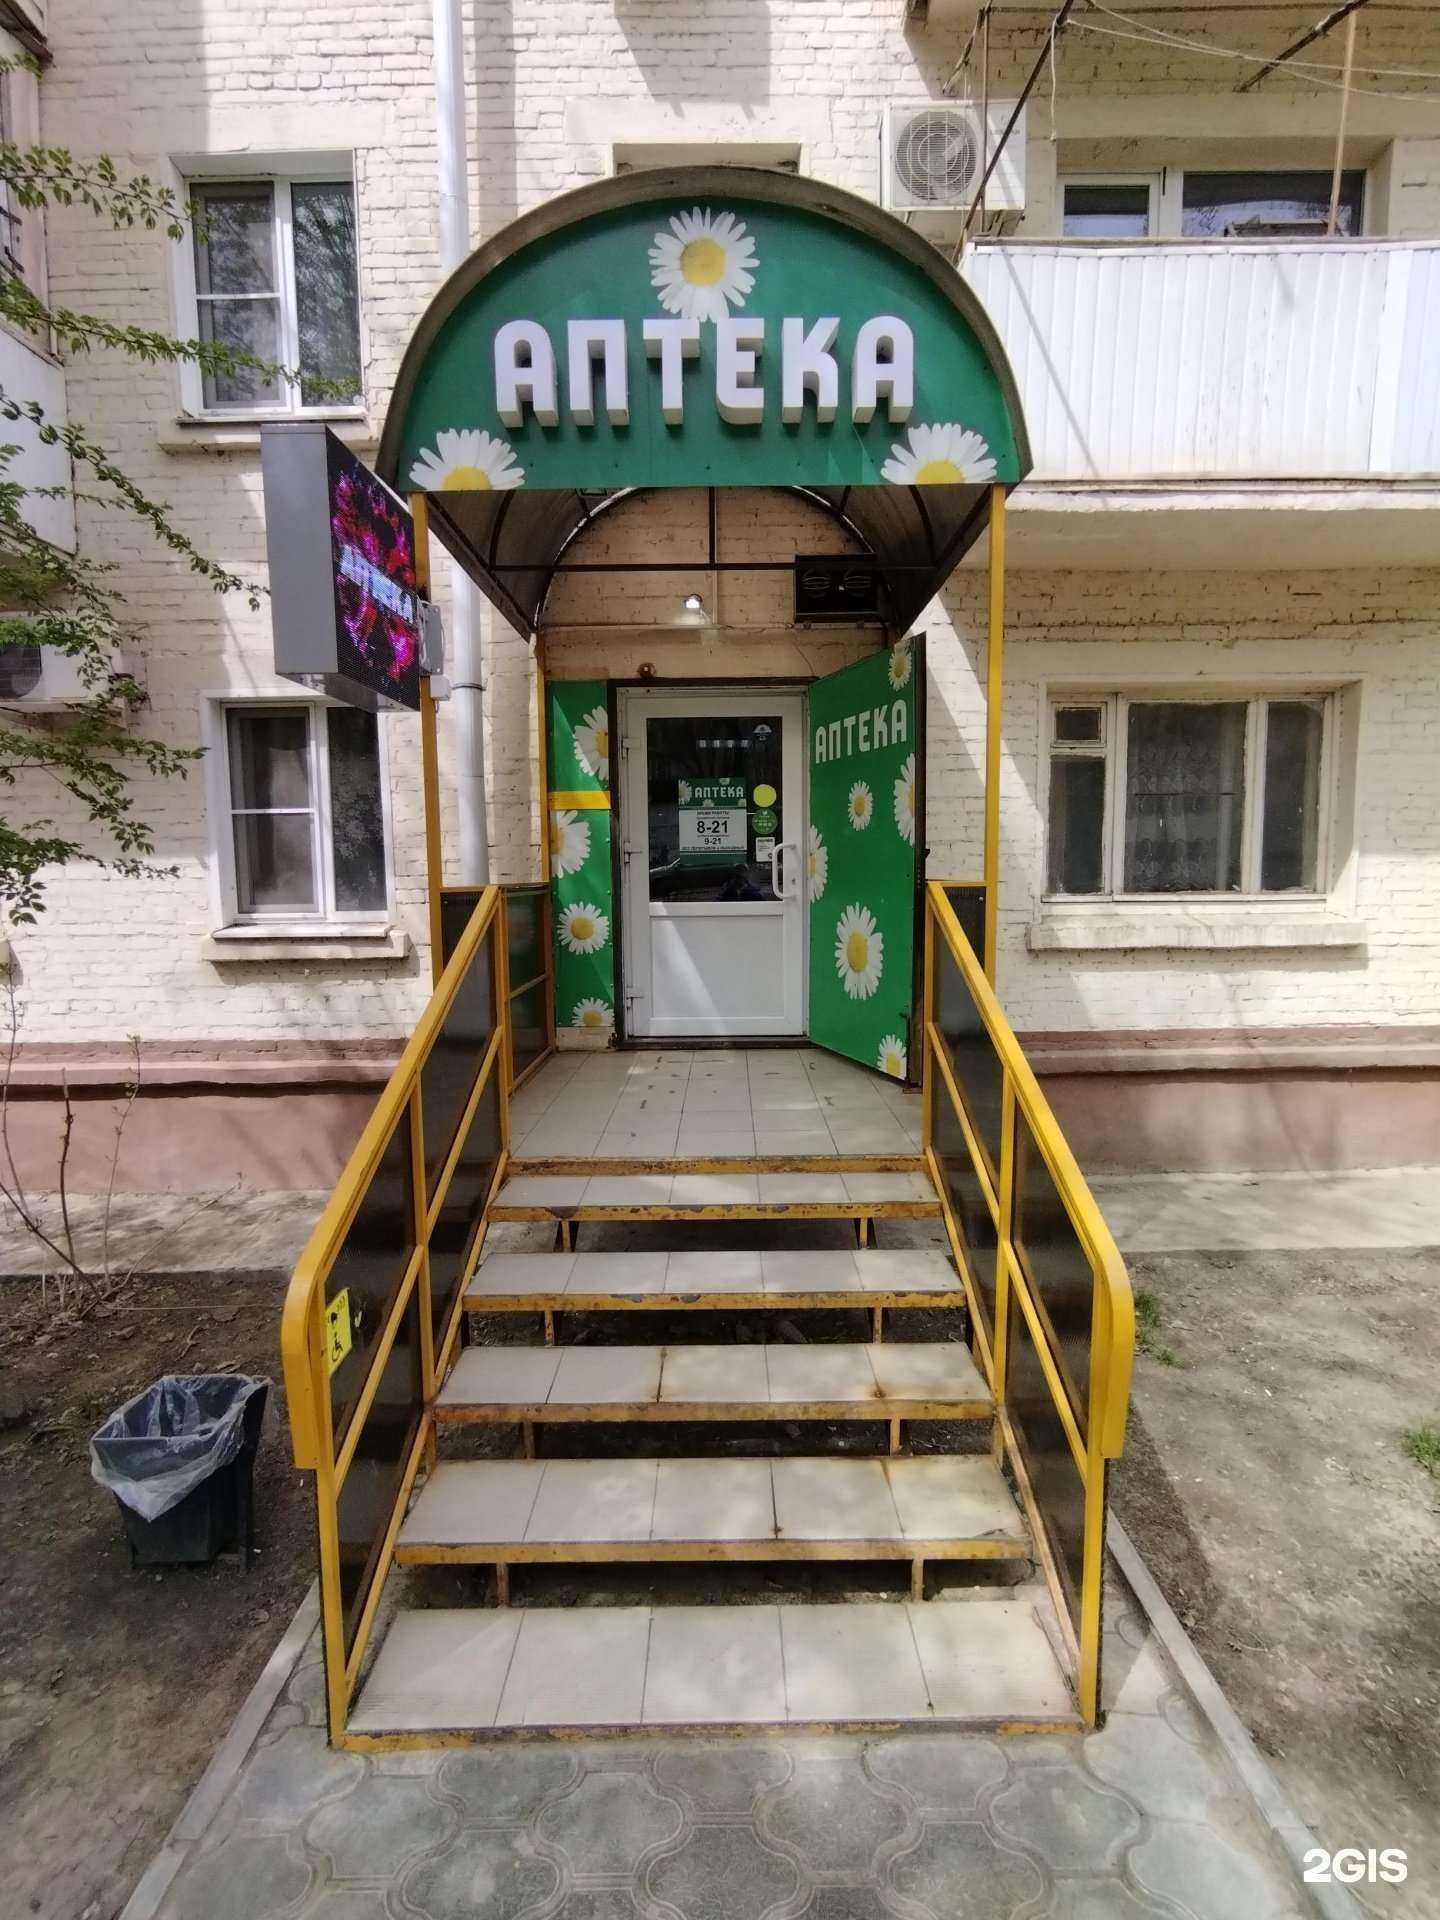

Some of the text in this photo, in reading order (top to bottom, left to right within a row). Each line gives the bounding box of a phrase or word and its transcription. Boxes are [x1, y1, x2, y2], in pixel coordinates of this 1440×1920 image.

[494, 316, 914, 427] АПТЕКА
[815, 699, 907, 764] АПТЕКА
[695, 786, 744, 798] АПТЕКА
[697, 820, 728, 834] 8-21
